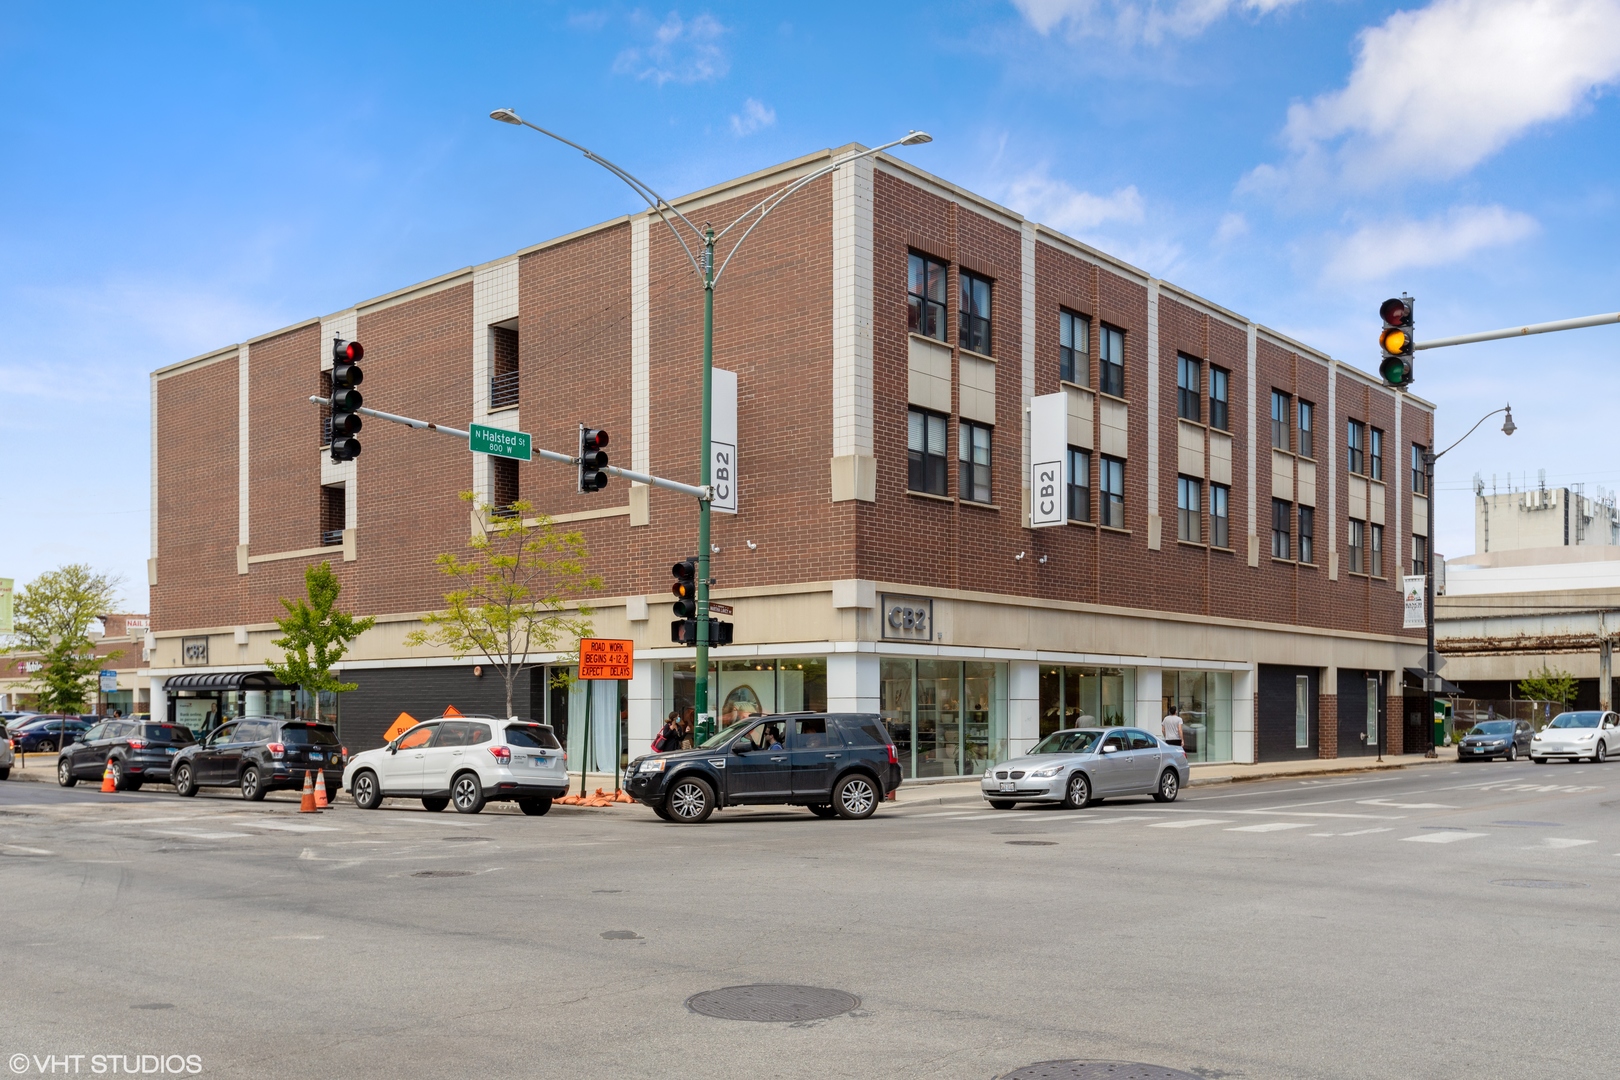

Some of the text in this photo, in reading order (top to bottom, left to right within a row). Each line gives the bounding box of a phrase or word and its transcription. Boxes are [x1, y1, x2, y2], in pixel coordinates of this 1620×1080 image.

[475, 430, 526, 447] N Halsted St
[489, 443, 513, 454] 800 W
[716, 451, 730, 500] CB2
[1040, 470, 1055, 516] CB2
[888, 606, 926, 630] CB2
[186, 643, 206, 659] CB2
[591, 642, 624, 652] ROAD WORK
[585, 653, 607, 664] BEGINS
[582, 666, 630, 677] EXPECT DELAYS
